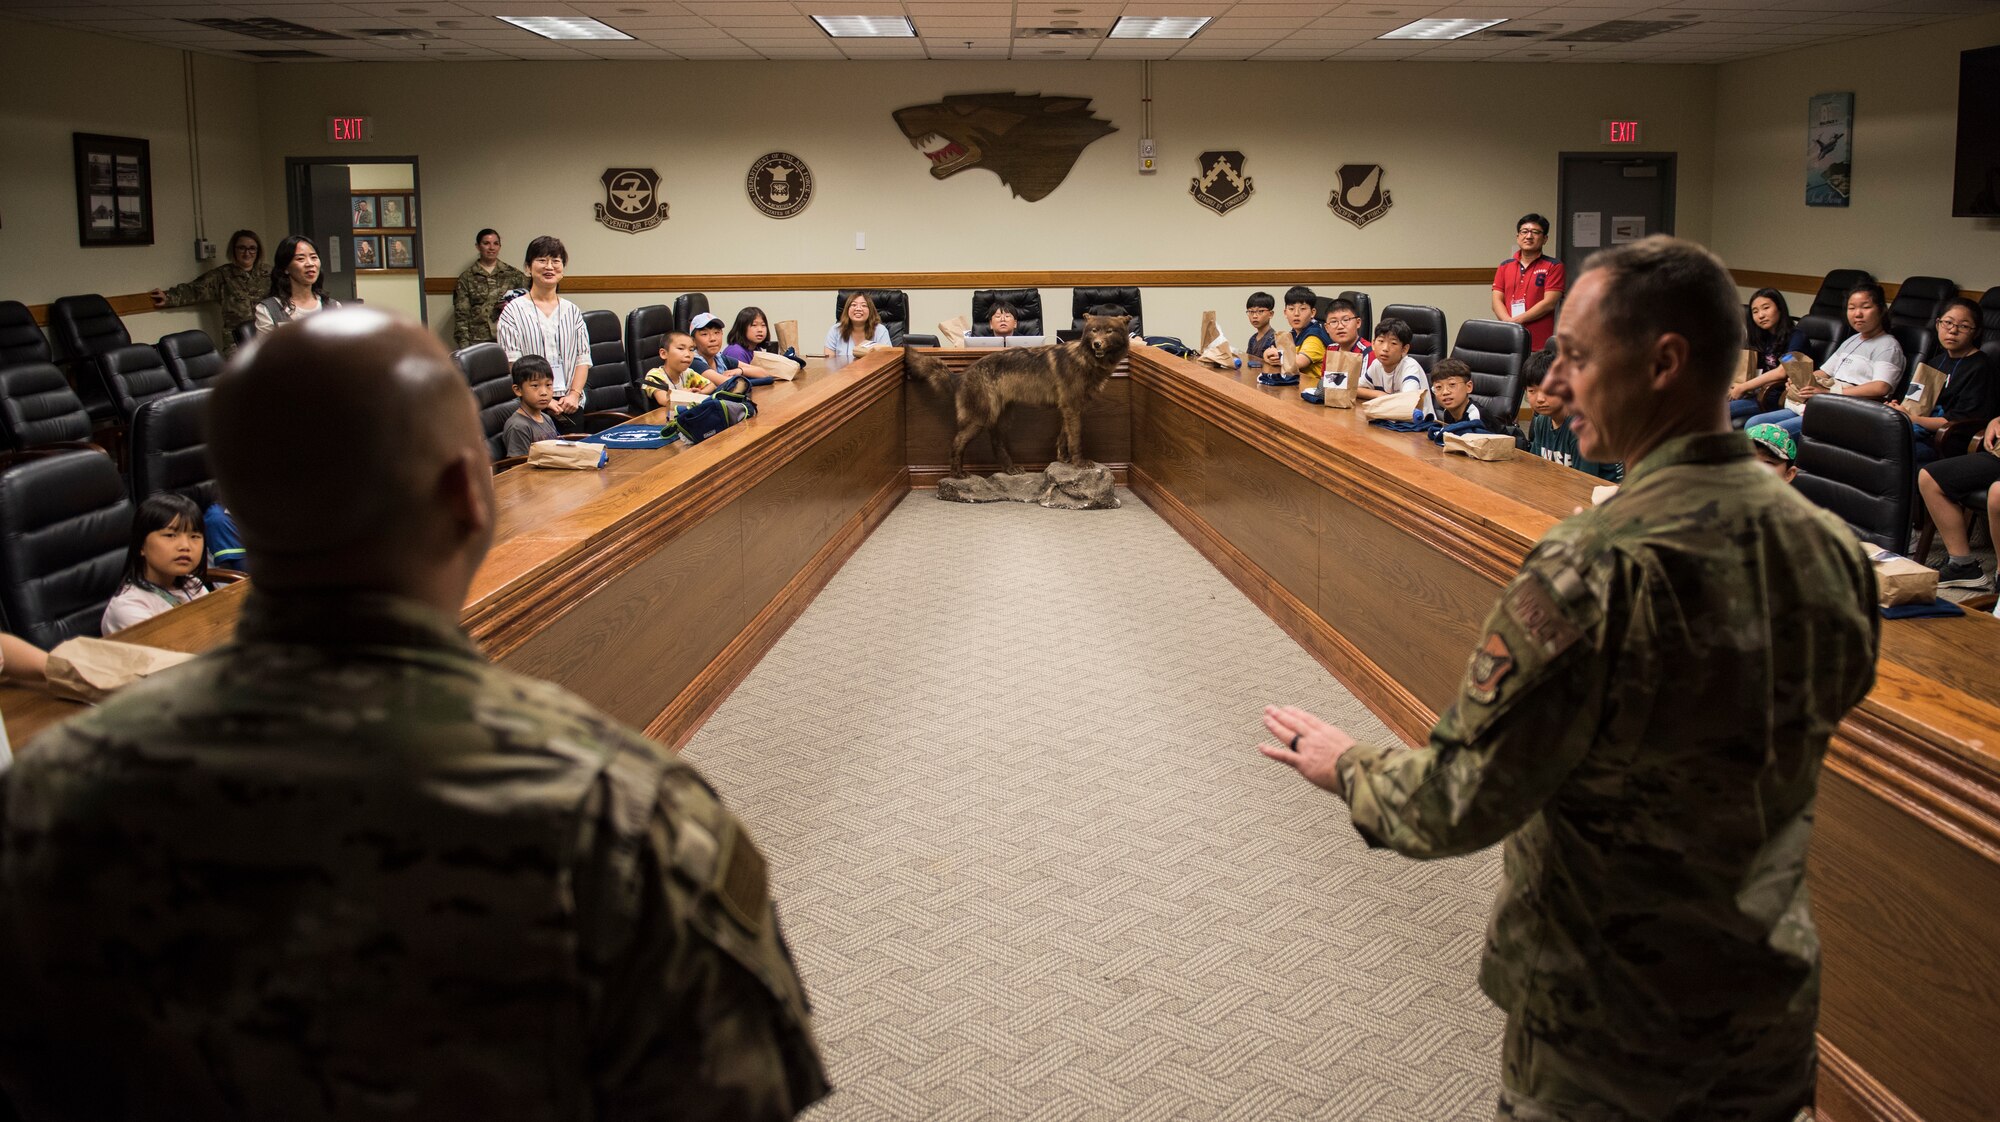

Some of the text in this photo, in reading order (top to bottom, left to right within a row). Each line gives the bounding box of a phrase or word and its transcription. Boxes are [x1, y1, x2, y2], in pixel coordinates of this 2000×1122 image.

[334, 118, 363, 140] EXIT
[1611, 122, 1638, 142] EXIT
[748, 156, 769, 193] DEPARTMENT
[782, 153, 794, 161] THE
[794, 160, 806, 172] AIR
[803, 171, 811, 194] FORCE
[602, 214, 661, 231] SEVENTH AIR FORCE
[1333, 203, 1355, 219] PACIFIC
[1355, 217, 1366, 225] AIR
